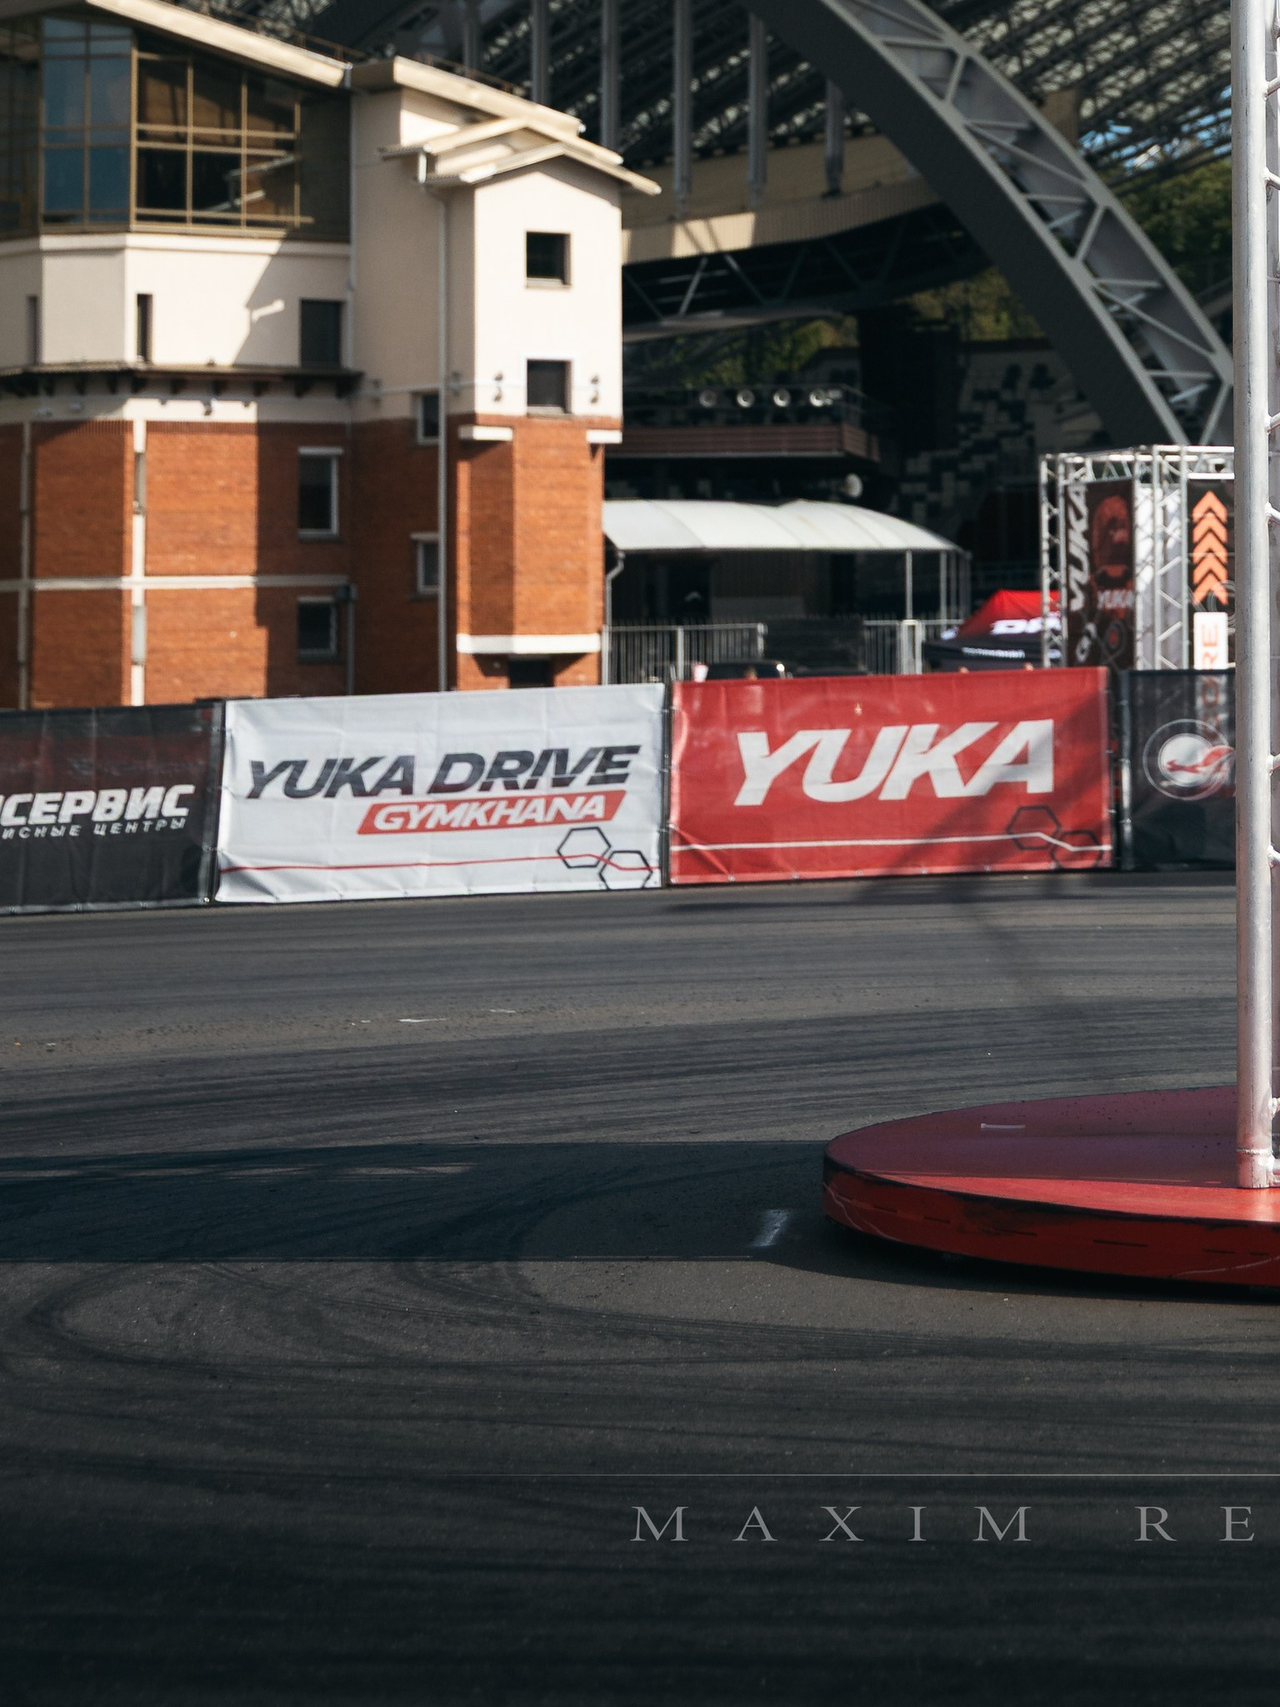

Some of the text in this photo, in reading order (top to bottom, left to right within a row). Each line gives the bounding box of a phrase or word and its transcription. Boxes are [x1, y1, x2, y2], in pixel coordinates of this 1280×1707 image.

[245, 745, 641, 799] YUKA DRIVE
[733, 718, 1055, 806] YUKA
[0, 784, 196, 827] СЕРВИС
[93, 818, 187, 836] ЦЕНТРЫ
[372, 795, 607, 831] GYMKHANA
